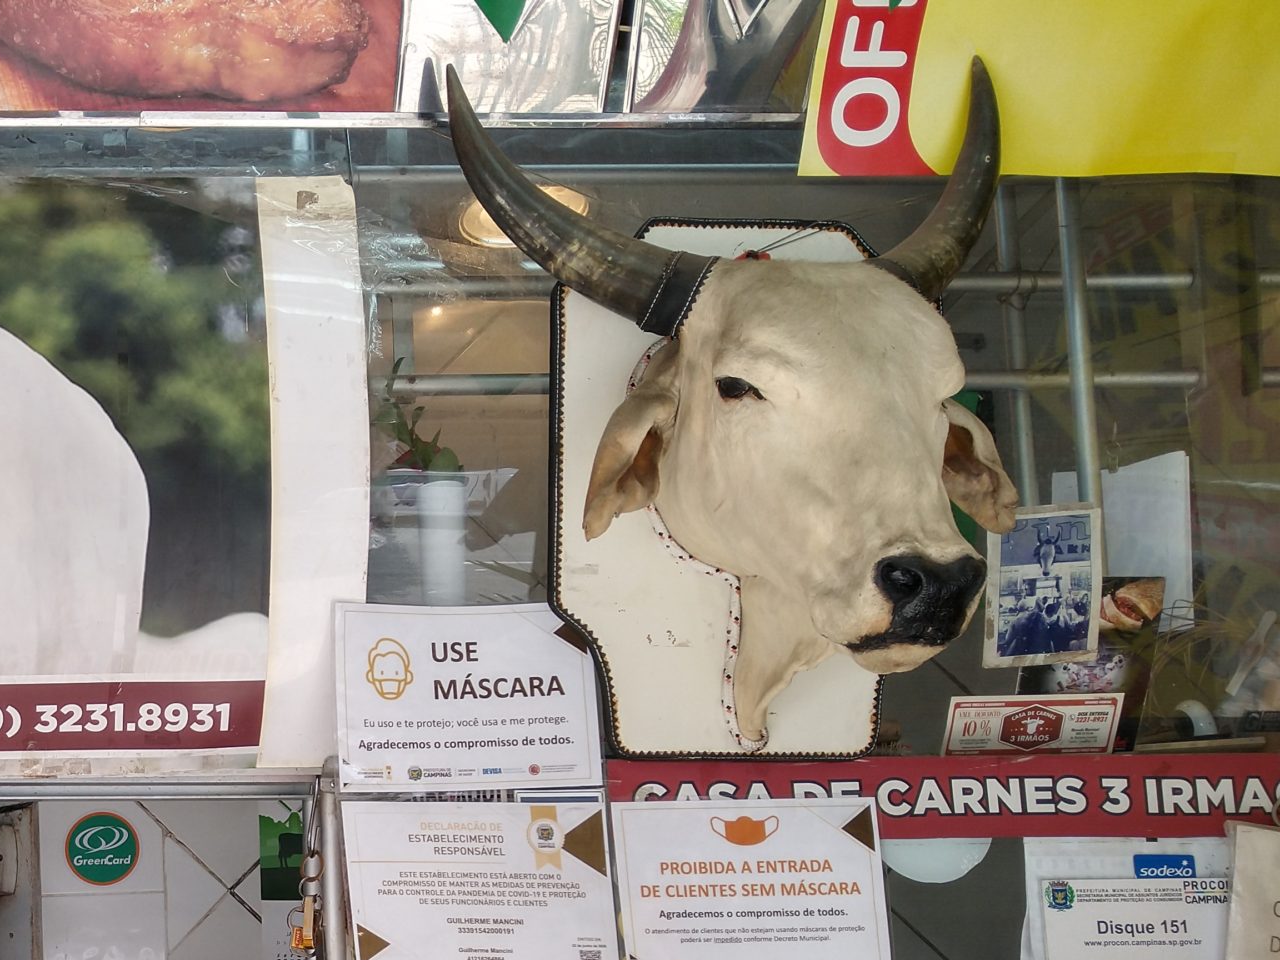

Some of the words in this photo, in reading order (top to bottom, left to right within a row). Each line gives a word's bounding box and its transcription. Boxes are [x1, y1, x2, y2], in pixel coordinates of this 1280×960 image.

[831, 0, 917, 147] OF
[431, 641, 479, 663] USE
[433, 674, 565, 700] MÁSCARA
[33, 701, 232, 734] 3231.8931
[359, 738, 431, 751] Agradecemos
[434, 741, 441, 749] o
[444, 738, 519, 750] compromisso
[521, 736, 535, 747] de
[538, 735, 574, 746] todos.
[877, 778, 1088, 815] CARNES
[1101, 778, 1131, 815] 3
[1144, 776, 1280, 815] IRMA
[420, 821, 487, 832] DECLARAÇÃO
[489, 821, 503, 831] DE
[408, 834, 504, 844] ESTABELECIMENTO
[434, 845, 506, 856] RESPONSÁVEL
[73, 854, 132, 866] GreenCard
[660, 861, 736, 876] PROIBIDA
[741, 860, 753, 874] A
[757, 859, 833, 874] ENTRADA
[1140, 865, 1193, 877] sodexo
[640, 885, 660, 898] DE
[665, 884, 737, 898] CLIENTES
[741, 883, 775, 897] SEM
[780, 879, 862, 896] MÁSCARA
[447, 917, 491, 925] GUILHERME
[493, 917, 524, 925] MANCINI
[659, 909, 724, 921] Agradecemos
[735, 908, 800, 920] compromisso
[803, 907, 815, 917] de
[817, 907, 849, 917] todos.
[1097, 920, 1154, 937] Disque
[1160, 920, 1188, 933] 151
